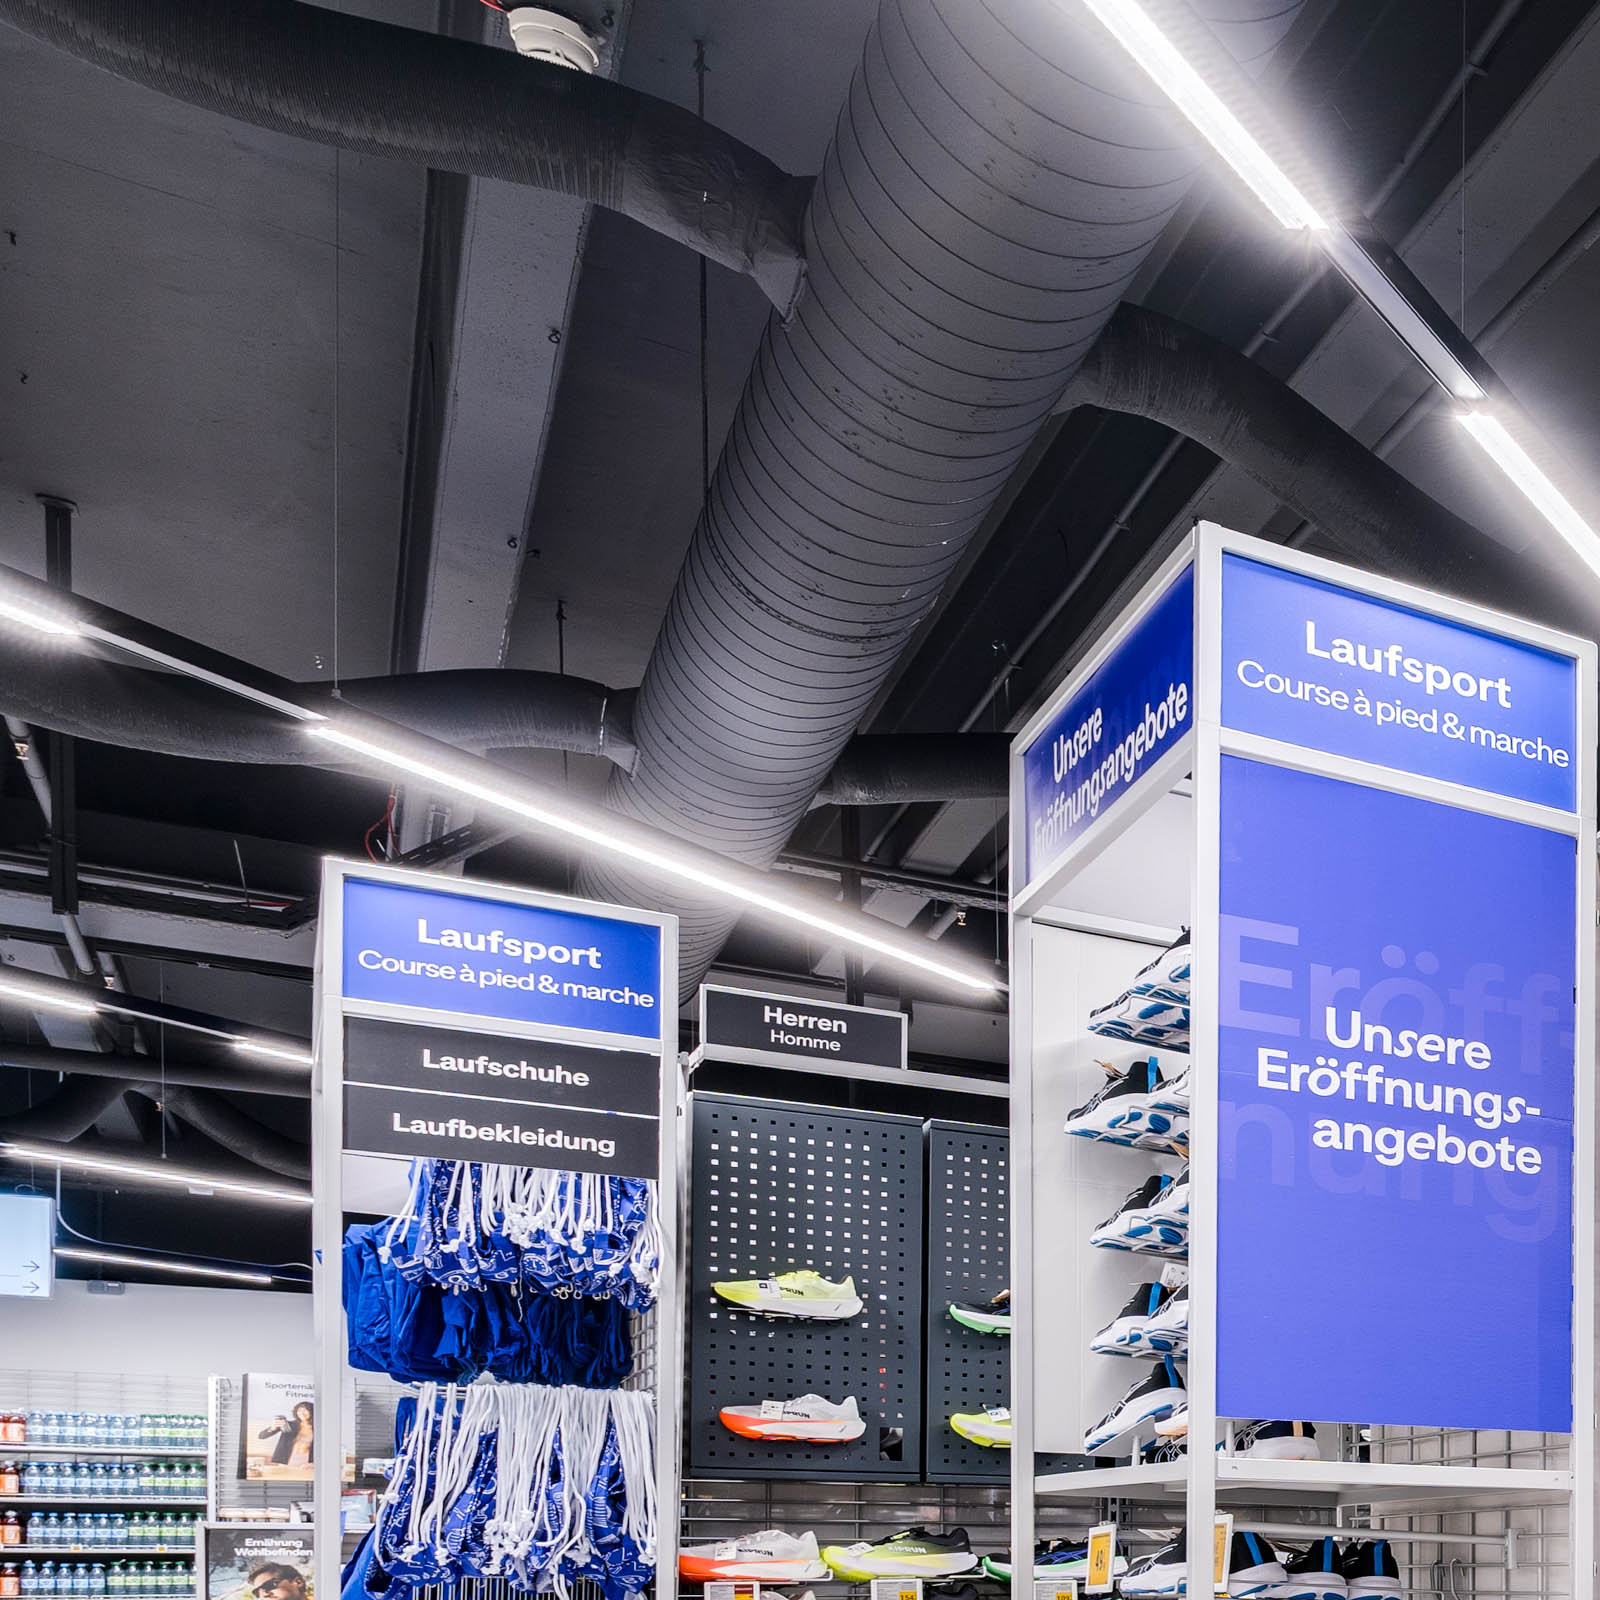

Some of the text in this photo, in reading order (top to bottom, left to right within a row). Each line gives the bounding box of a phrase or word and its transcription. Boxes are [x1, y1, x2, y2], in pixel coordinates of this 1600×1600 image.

[1305, 620, 1512, 710] Laufsport
[1237, 660, 1569, 769] Course à pied & marche
[1034, 682, 1188, 857] Eröffnungsangebote
[1053, 707, 1103, 783] Unsere
[417, 918, 602, 969] Laufsport
[358, 949, 655, 1009] Course à pied & marche
[763, 1005, 848, 1035] Herren
[769, 1029, 841, 1053] Homme
[1325, 1006, 1492, 1070] Unsere
[422, 1048, 590, 1087] Laufschuhe
[1257, 1047, 1541, 1130] Eröffnungs-
[393, 1112, 616, 1158] Laufbekleidung
[1312, 1118, 1542, 1175] angebote
